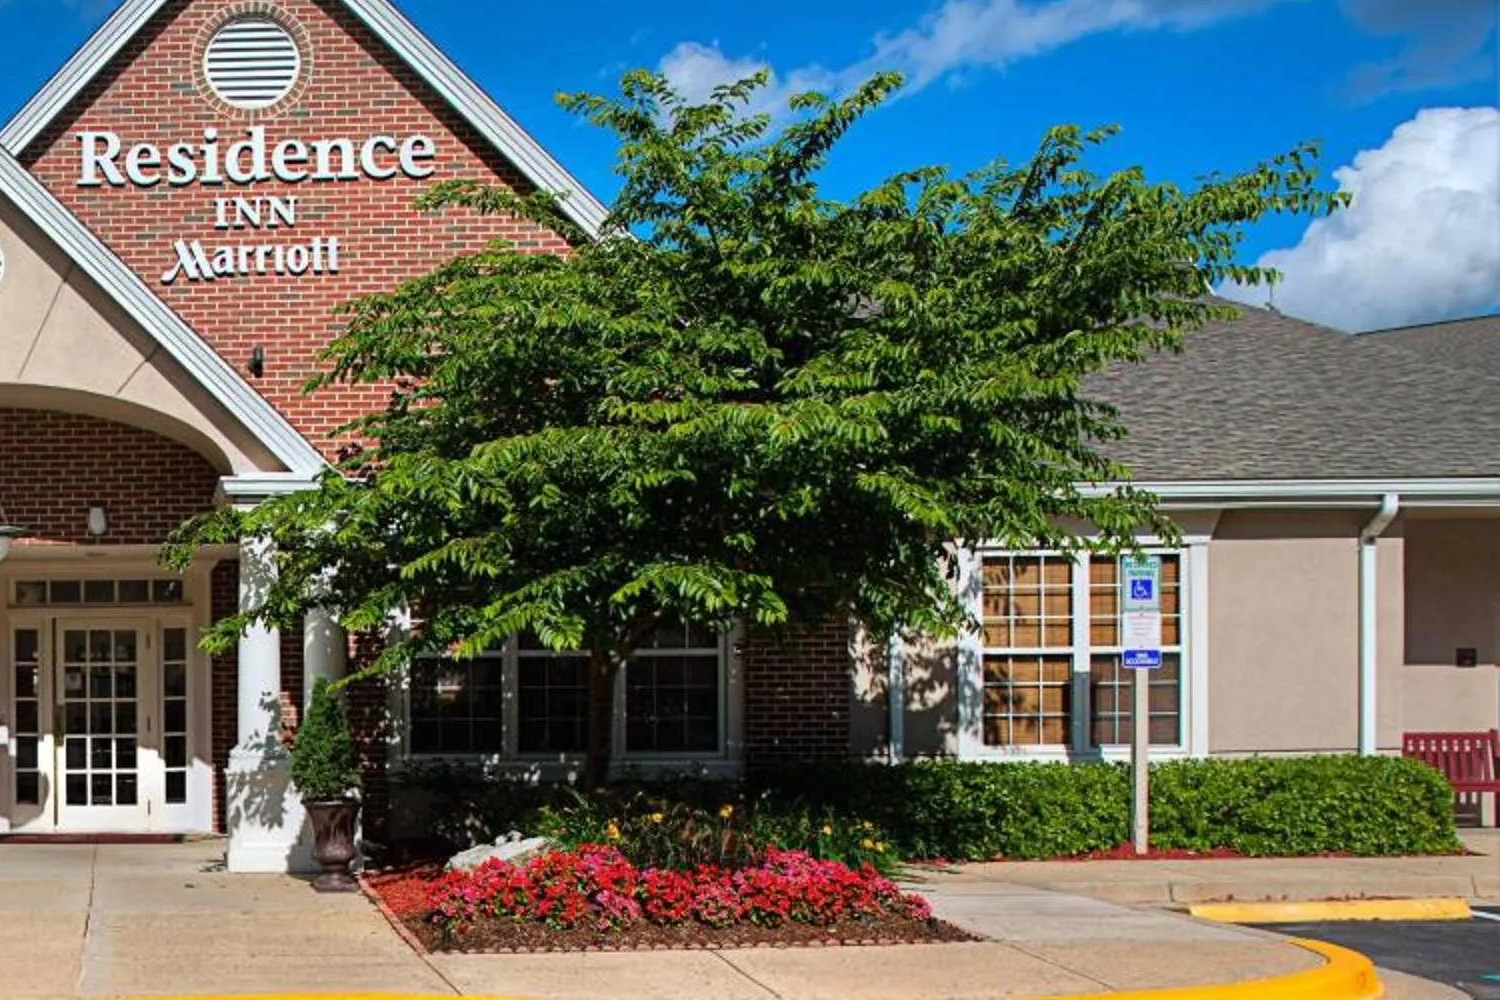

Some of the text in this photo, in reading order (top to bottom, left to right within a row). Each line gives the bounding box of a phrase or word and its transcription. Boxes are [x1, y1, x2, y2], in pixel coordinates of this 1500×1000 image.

[77, 126, 436, 186] Residence
[213, 196, 298, 229] INN
[161, 236, 340, 284] Marriott
